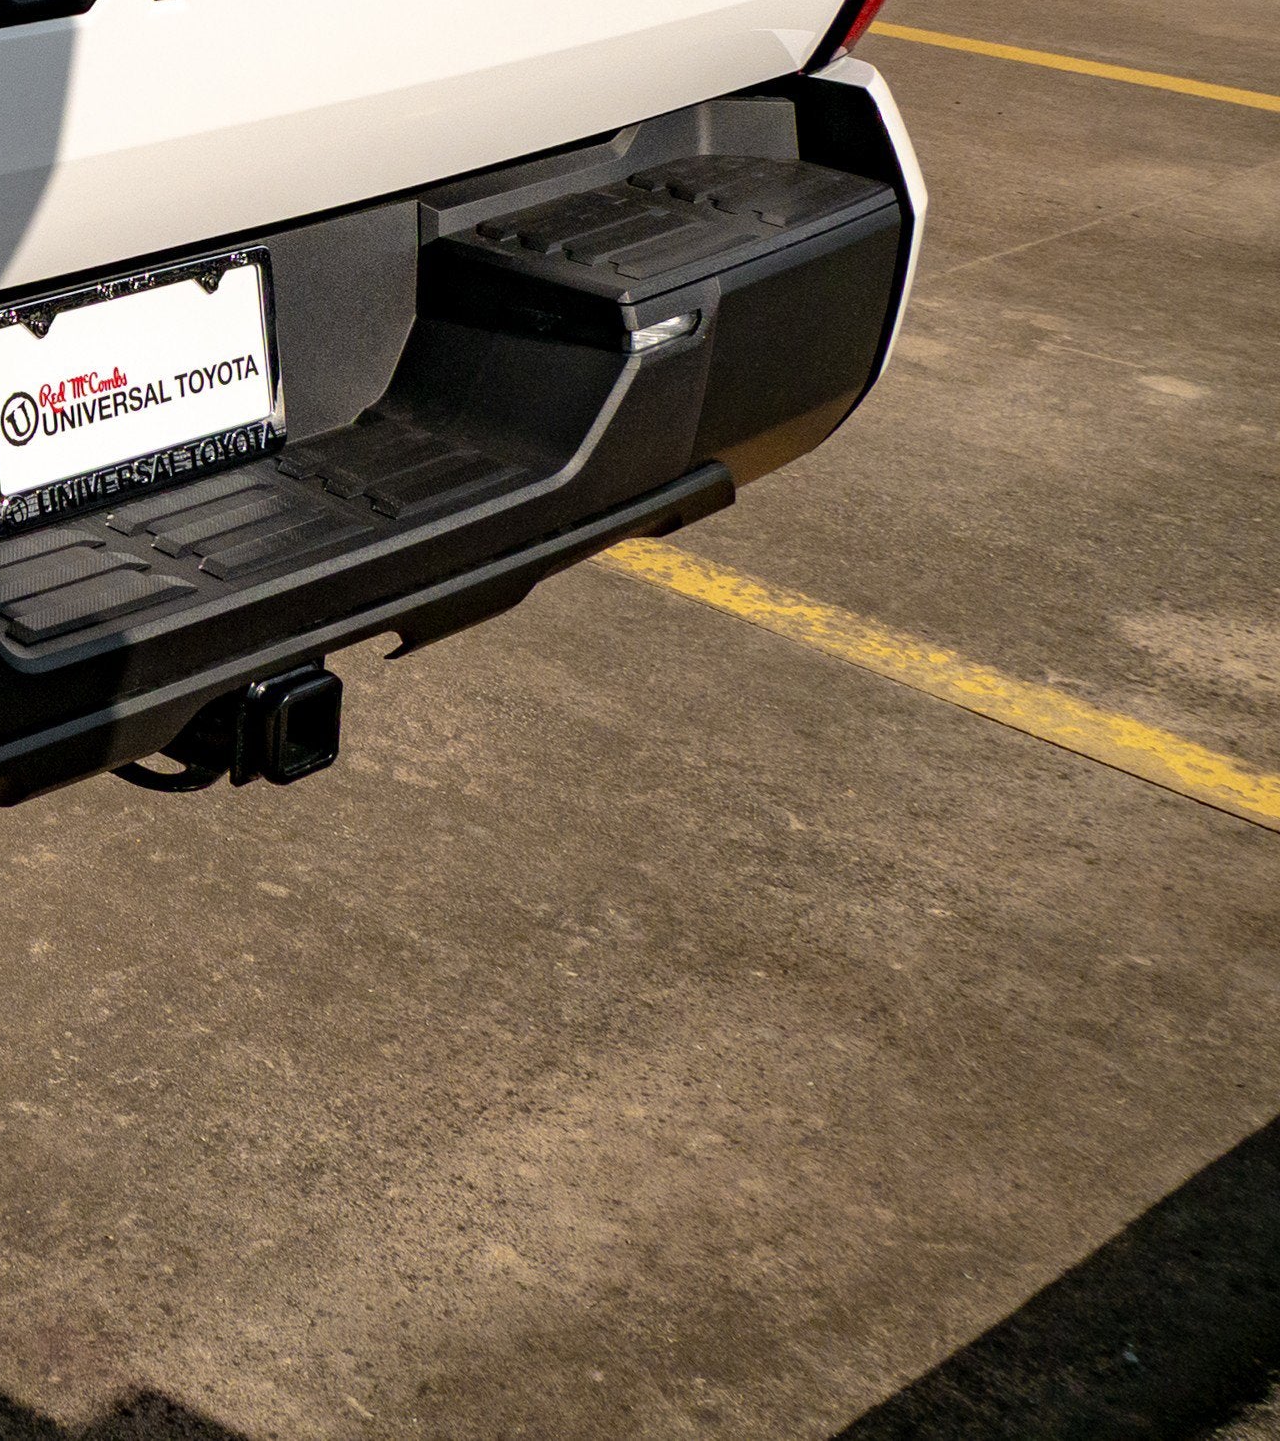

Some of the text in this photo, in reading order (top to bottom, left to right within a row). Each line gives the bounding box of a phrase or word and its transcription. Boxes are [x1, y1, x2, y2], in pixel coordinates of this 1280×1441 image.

[39, 381, 67, 414] Red
[42, 354, 260, 436] UNIVERSAL TOYOTA
[37, 421, 278, 514] UNIVERSAL TOYOTA
